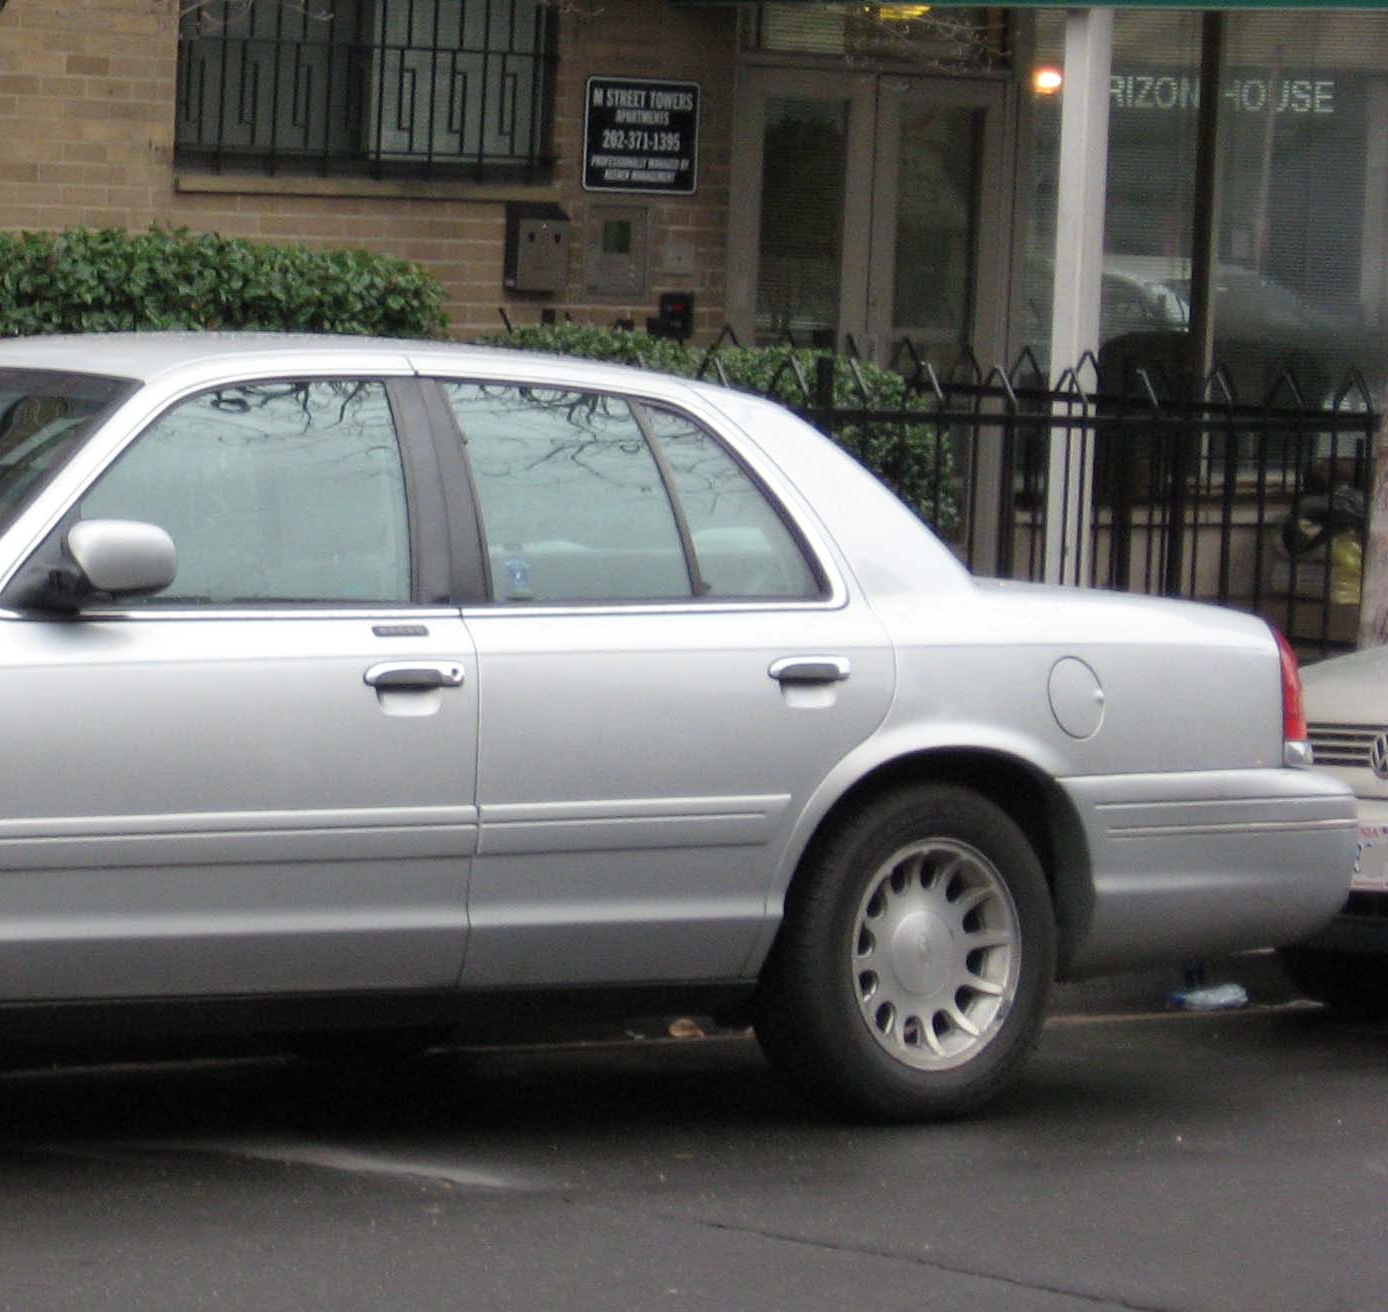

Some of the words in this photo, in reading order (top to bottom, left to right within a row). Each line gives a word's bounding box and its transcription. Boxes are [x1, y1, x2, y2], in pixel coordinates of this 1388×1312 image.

[593, 87, 603, 106] M
[607, 88, 645, 108] STREET
[650, 91, 693, 110] TOWERS
[1223, 79, 1335, 114] HOUSE
[616, 109, 669, 125] APARTMENTS
[603, 130, 680, 151] 202-371-1395
